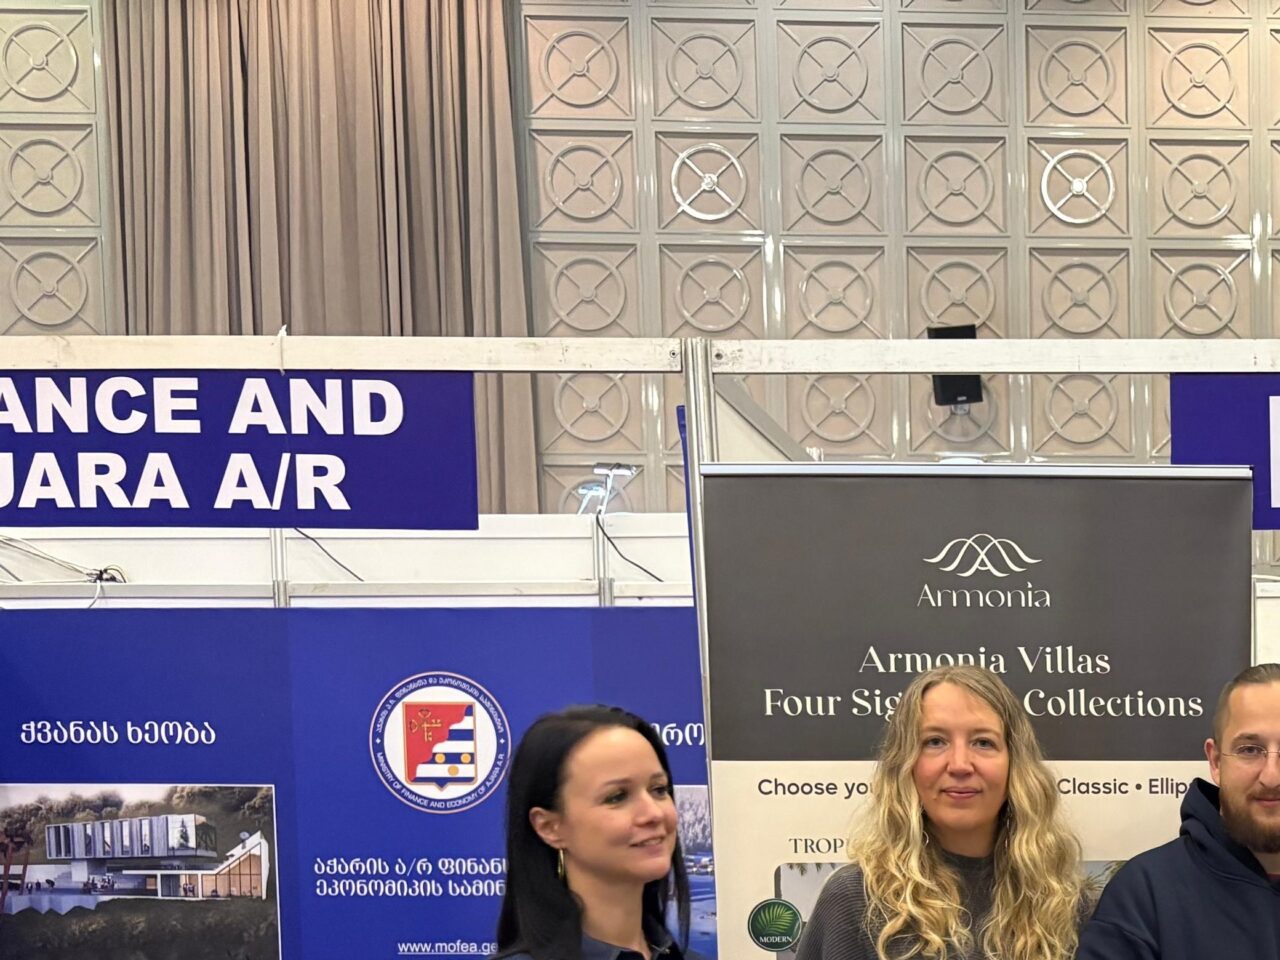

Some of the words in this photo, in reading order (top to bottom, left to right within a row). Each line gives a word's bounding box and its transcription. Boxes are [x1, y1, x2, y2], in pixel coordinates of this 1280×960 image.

[229, 378, 404, 435] AND
[214, 453, 351, 510] A/R
[917, 582, 1050, 607] Armonia
[1018, 645, 1111, 674] Villas
[764, 689, 842, 717] Four
[1023, 689, 1204, 718] Collections
[20, 721, 119, 744] ჭვანას
[127, 721, 217, 745] ხეობა
[758, 779, 839, 796] Choose
[1057, 777, 1129, 796] Classic
[1149, 777, 1189, 801] Ellip
[429, 799, 446, 809] AND
[789, 838, 845, 854] TROP
[314, 858, 389, 875] აჭარის
[395, 858, 433, 876] ა/რ
[316, 879, 443, 896] ეკონომიკის
